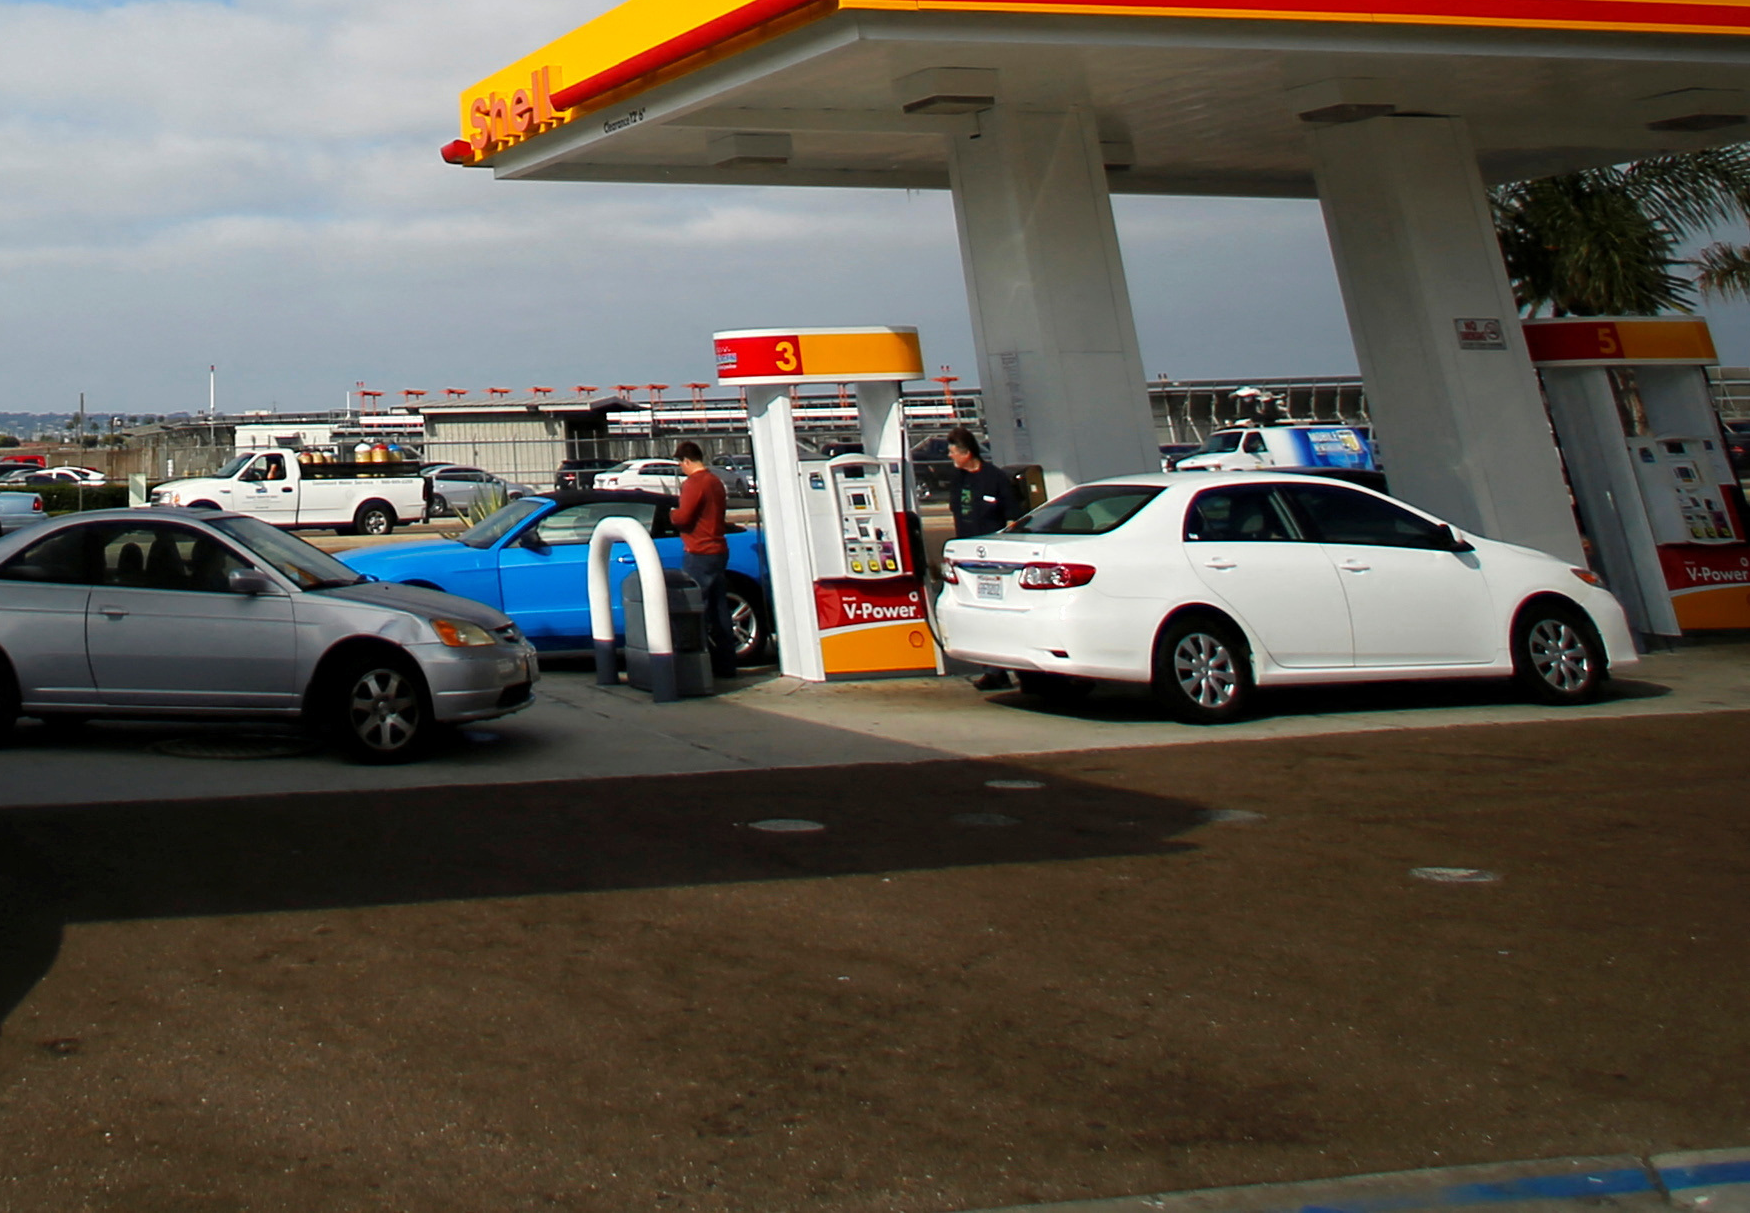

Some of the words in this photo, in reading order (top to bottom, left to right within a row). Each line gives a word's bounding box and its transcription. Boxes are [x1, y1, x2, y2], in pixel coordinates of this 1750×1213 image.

[470, 65, 560, 151] Shell
[603, 117, 630, 134] Clearance
[1597, 328, 1617, 354] 5
[775, 341, 798, 371] 3
[1685, 566, 1749, 582] V-Power
[843, 602, 917, 620] V-Power
